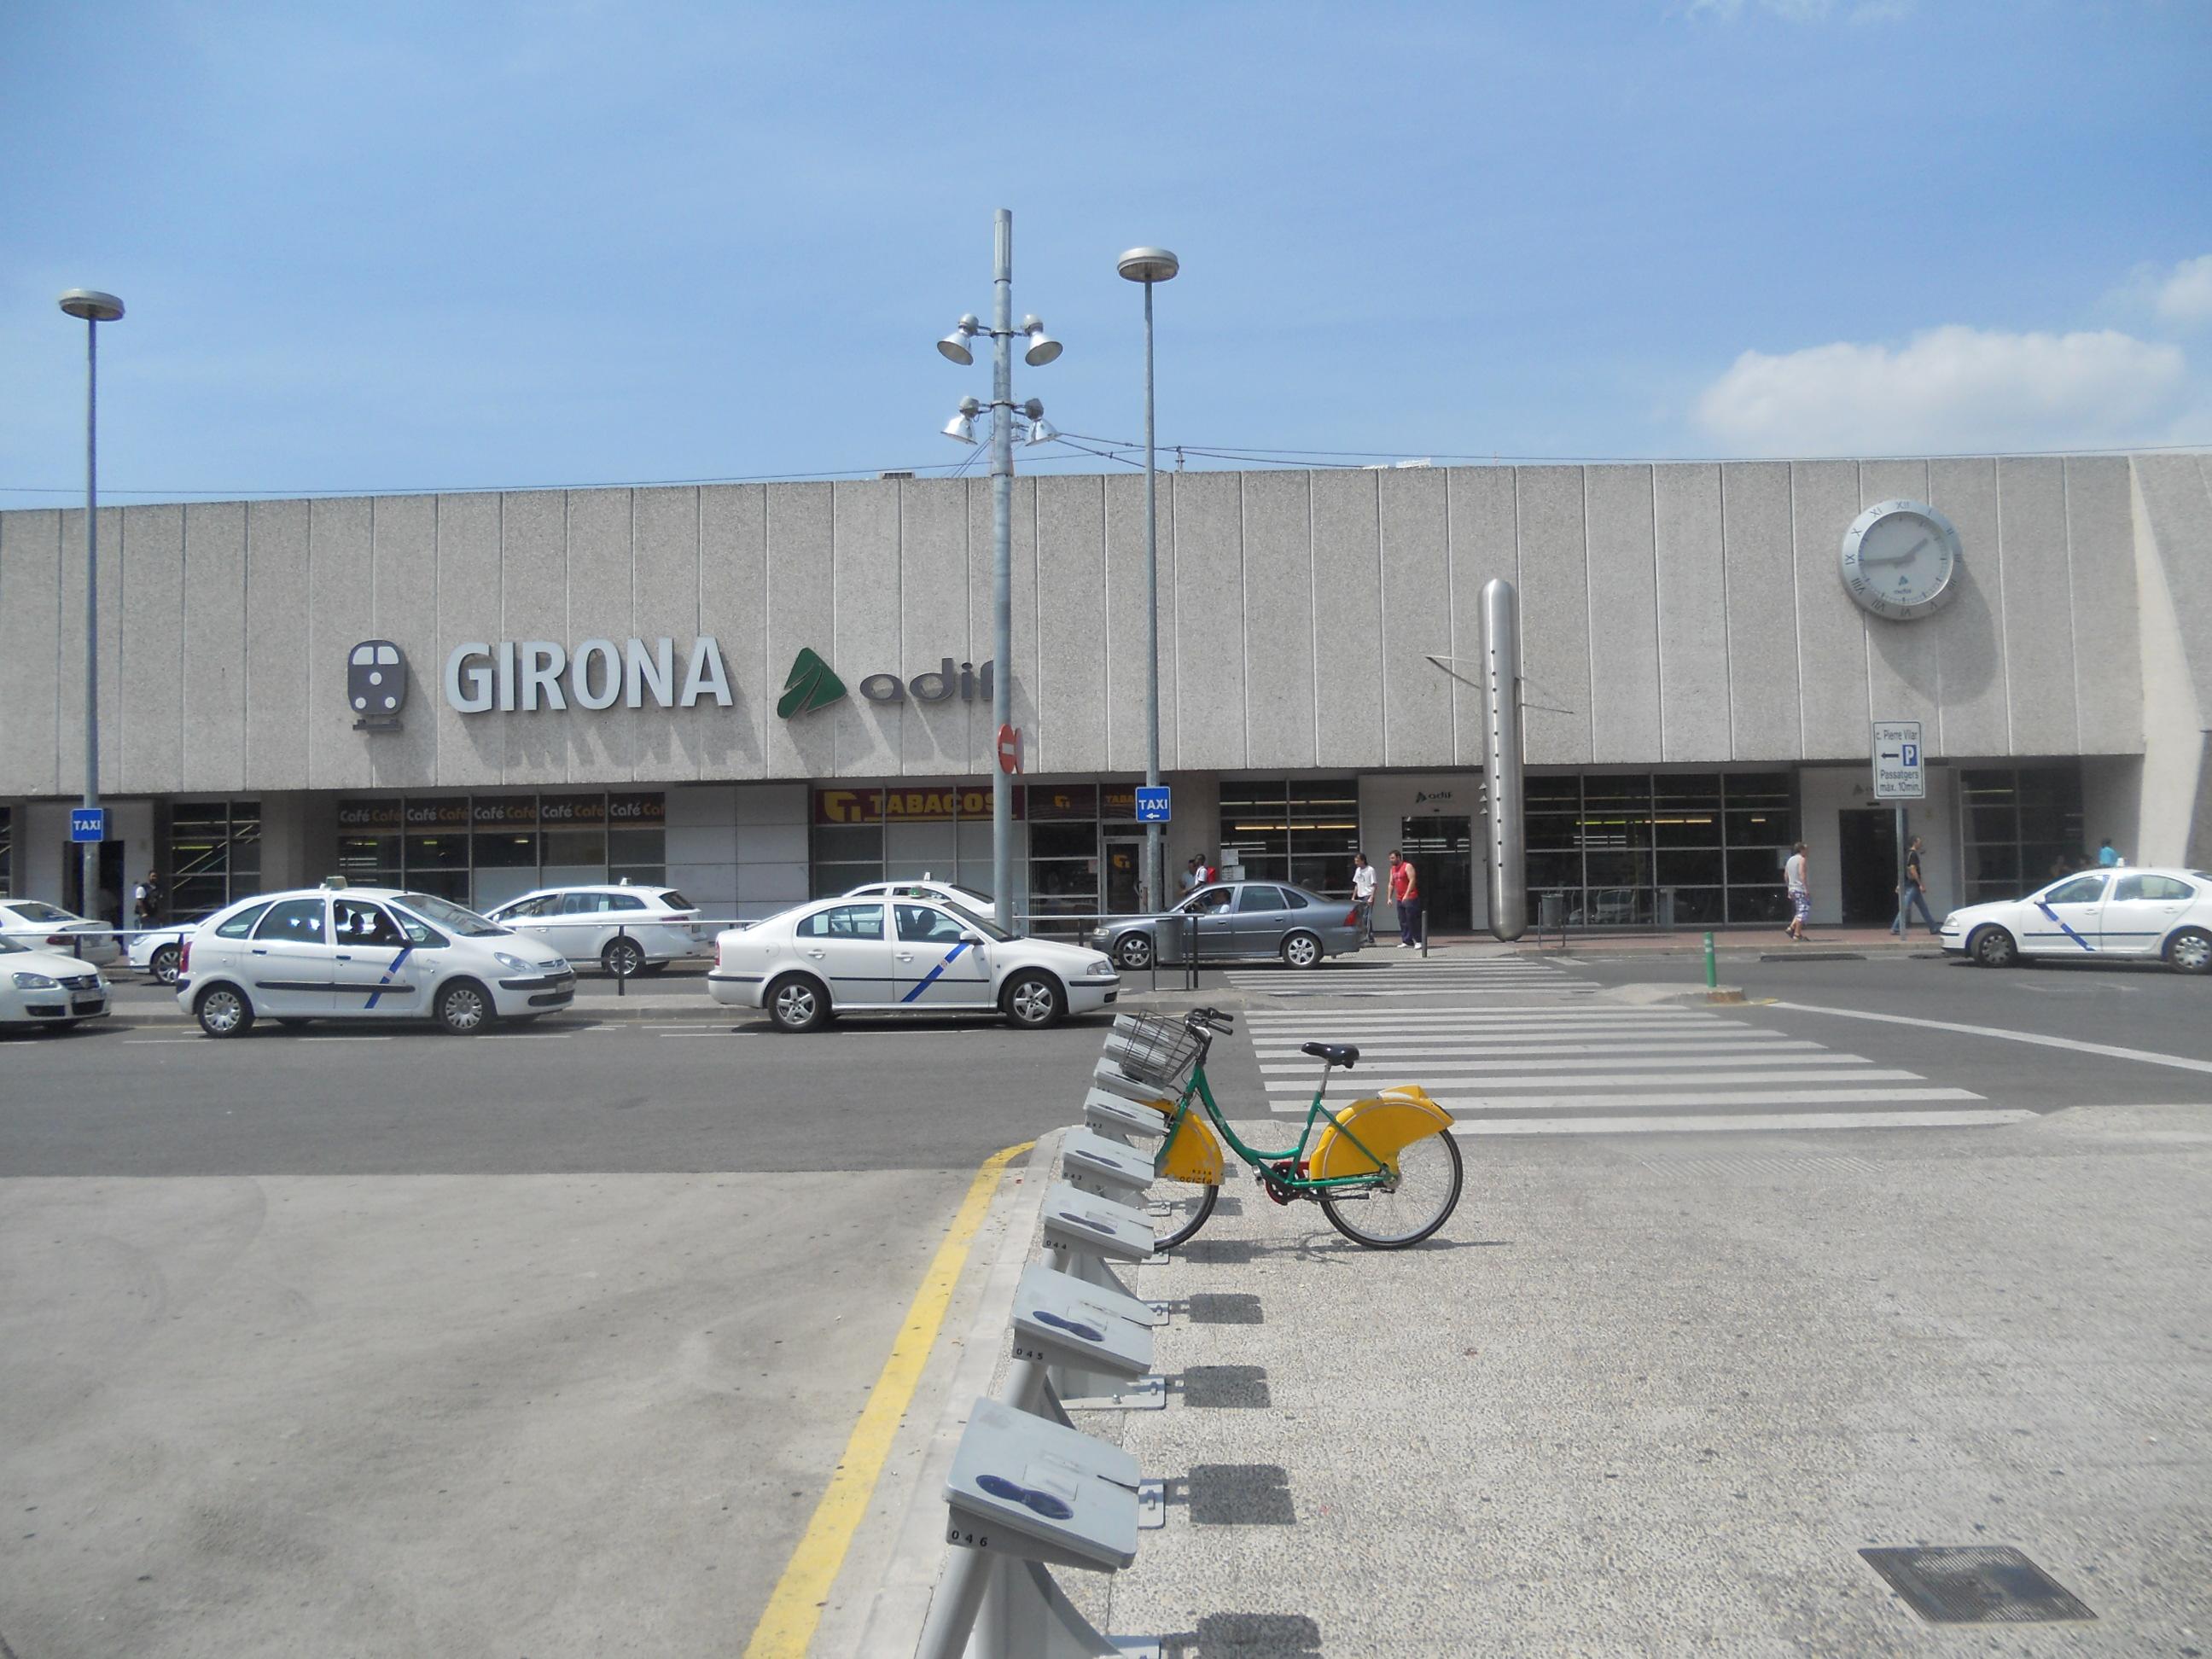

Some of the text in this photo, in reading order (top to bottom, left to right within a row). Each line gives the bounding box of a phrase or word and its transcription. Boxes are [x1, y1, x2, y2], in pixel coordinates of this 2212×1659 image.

[445, 637, 733, 713] GIRONA
[1883, 729, 1902, 741] Pierre
[1904, 729, 1918, 741] Vilar
[1880, 769, 1918, 781] Passatgers
[1106, 794, 1136, 805] TABA
[1138, 798, 1168, 811] TAXI
[406, 806, 437, 822] Café
[474, 806, 505, 820] Café
[542, 803, 573, 818] Café
[610, 801, 641, 817] Café
[340, 808, 370, 824] Café
[73, 819, 102, 831] TAXI
[1045, 1239, 1067, 1250] 044
[1016, 1348, 1044, 1360] 045
[951, 1529, 988, 1547] 046
